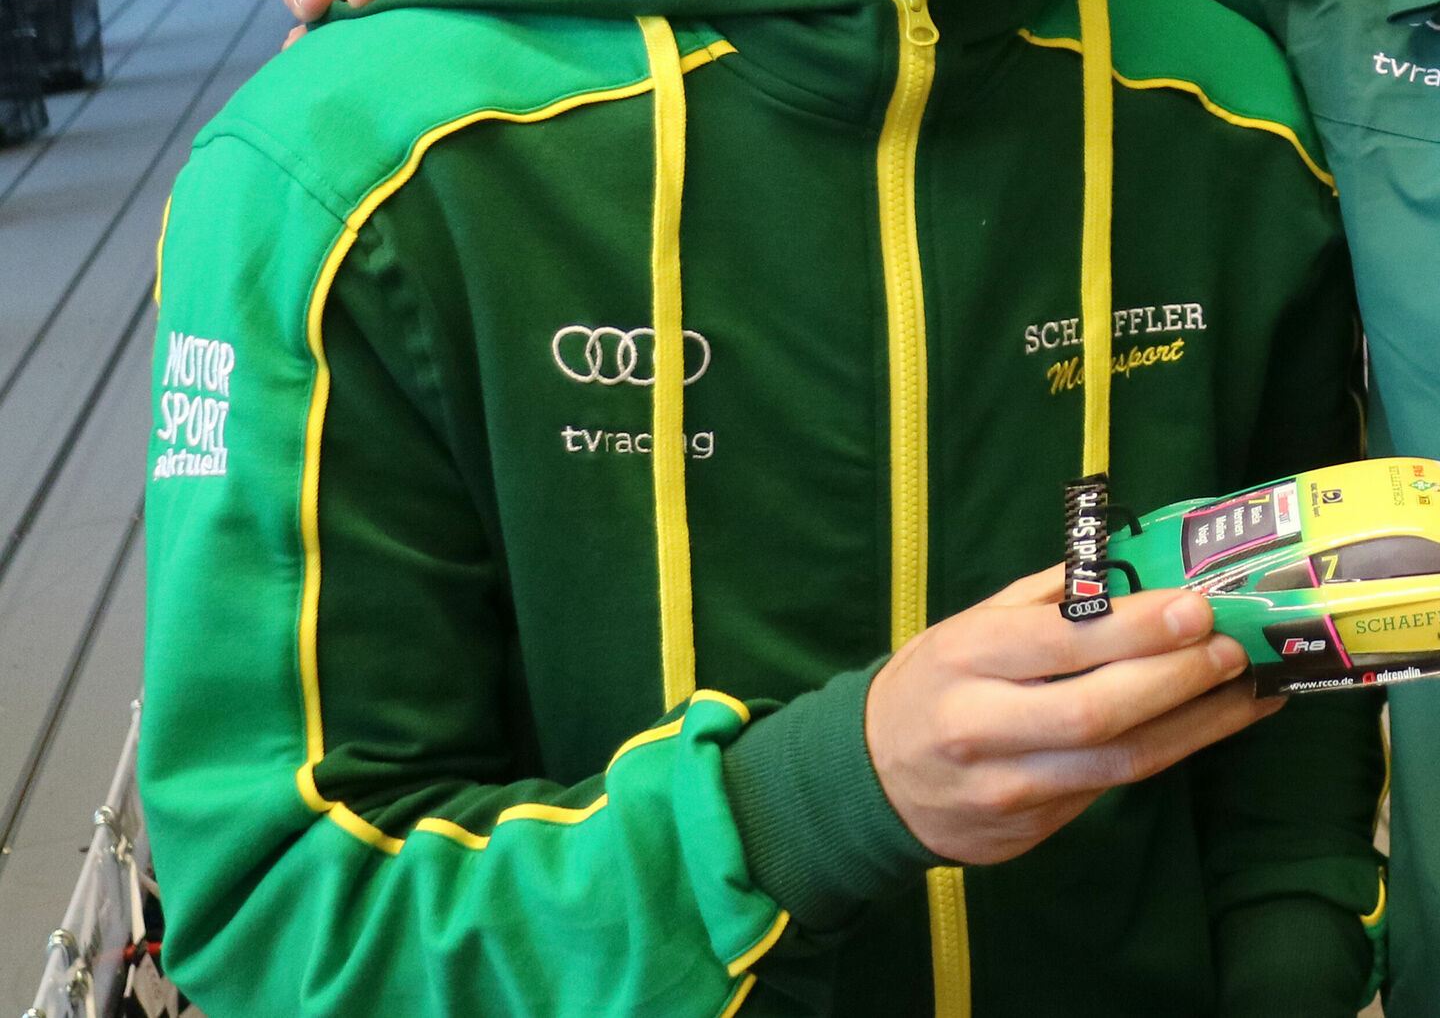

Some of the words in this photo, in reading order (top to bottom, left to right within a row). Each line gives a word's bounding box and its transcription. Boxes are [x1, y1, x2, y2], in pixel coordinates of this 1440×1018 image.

[1024, 302, 1207, 355] SCHFFLER
[162, 331, 235, 397] MOTOR
[157, 391, 230, 451] SPORT
[154, 448, 228, 482] aktuell
[1072, 492, 1101, 538] Sprt
[1320, 555, 1339, 580] 7
[1293, 639, 1326, 652] R8
[1289, 677, 1354, 691] www.rcco.de
[1376, 666, 1421, 683] adrenalin
